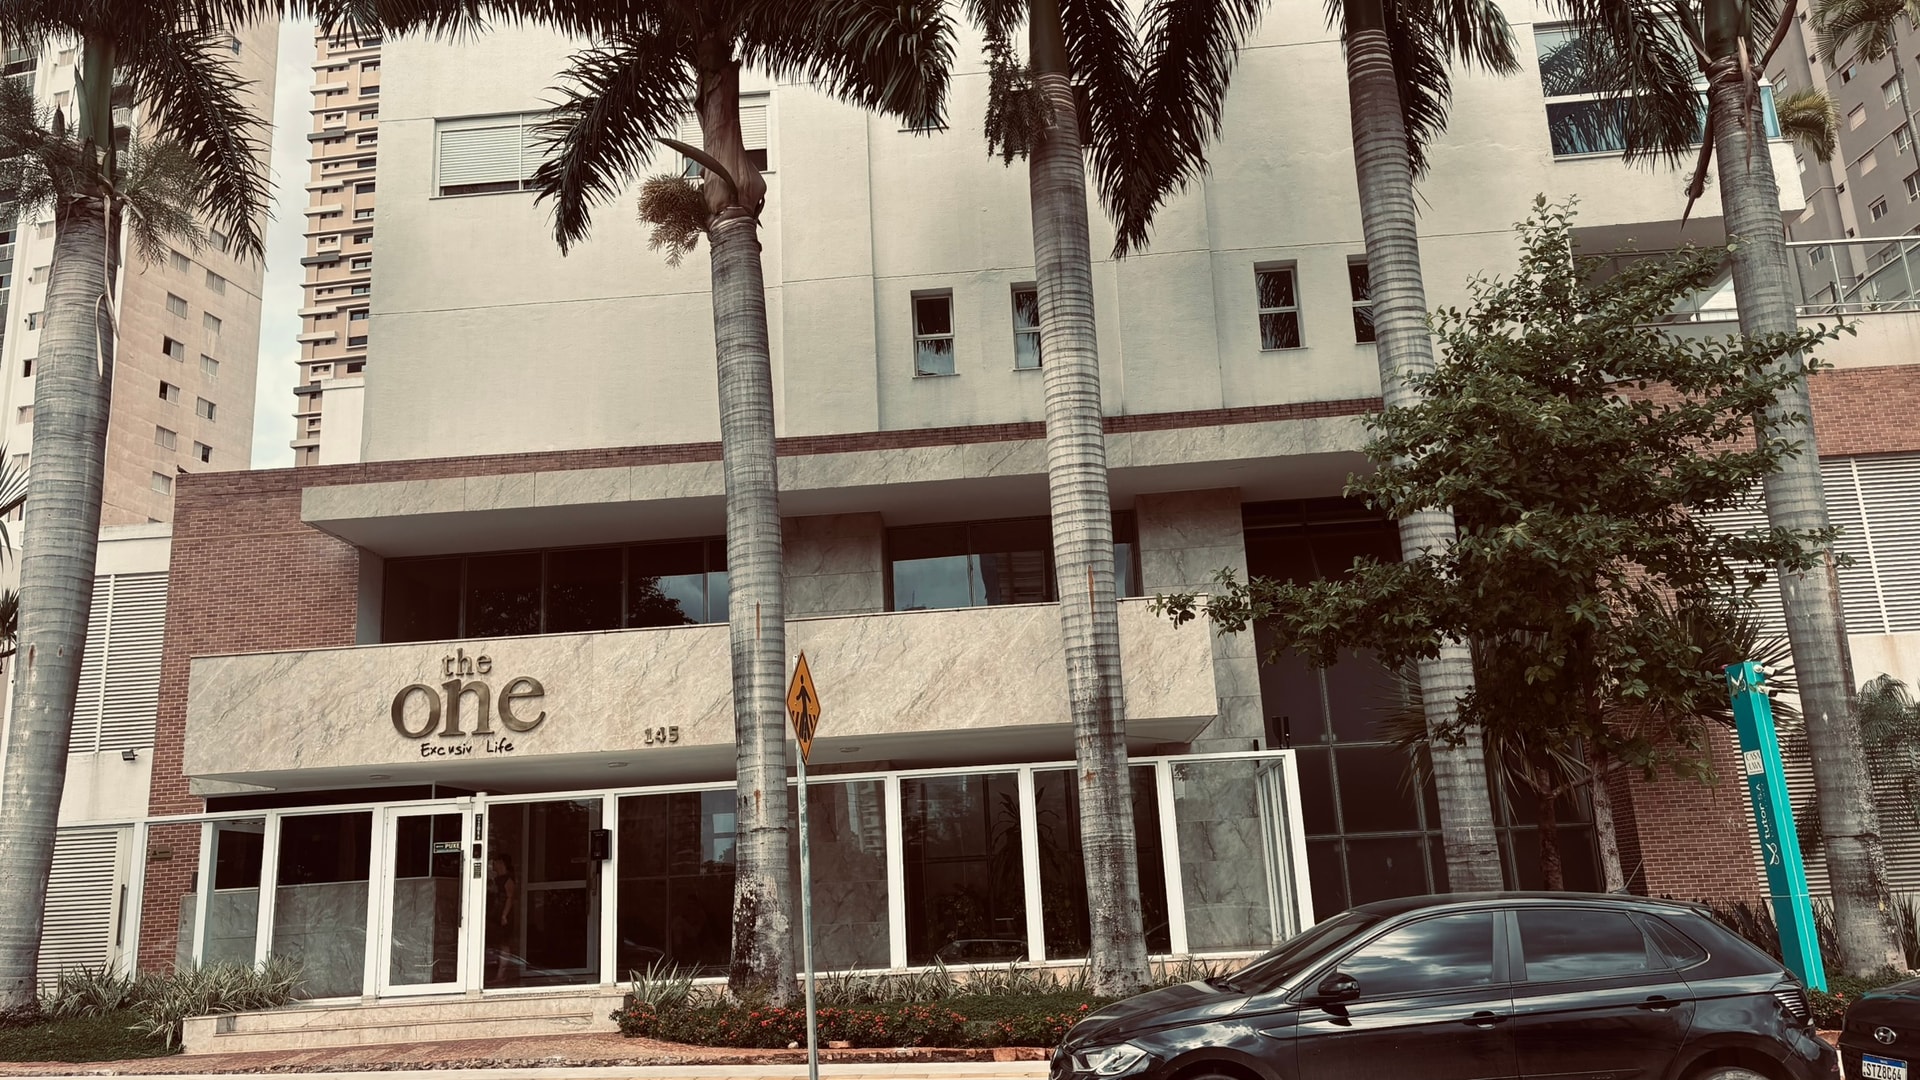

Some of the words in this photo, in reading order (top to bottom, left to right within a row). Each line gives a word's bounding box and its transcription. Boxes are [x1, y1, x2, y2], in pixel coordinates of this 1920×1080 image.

[442, 647, 493, 676] the
[390, 676, 546, 739] one
[486, 737, 515, 754] Life
[644, 725, 679, 744] 145
[1759, 803, 1770, 839] tutor
